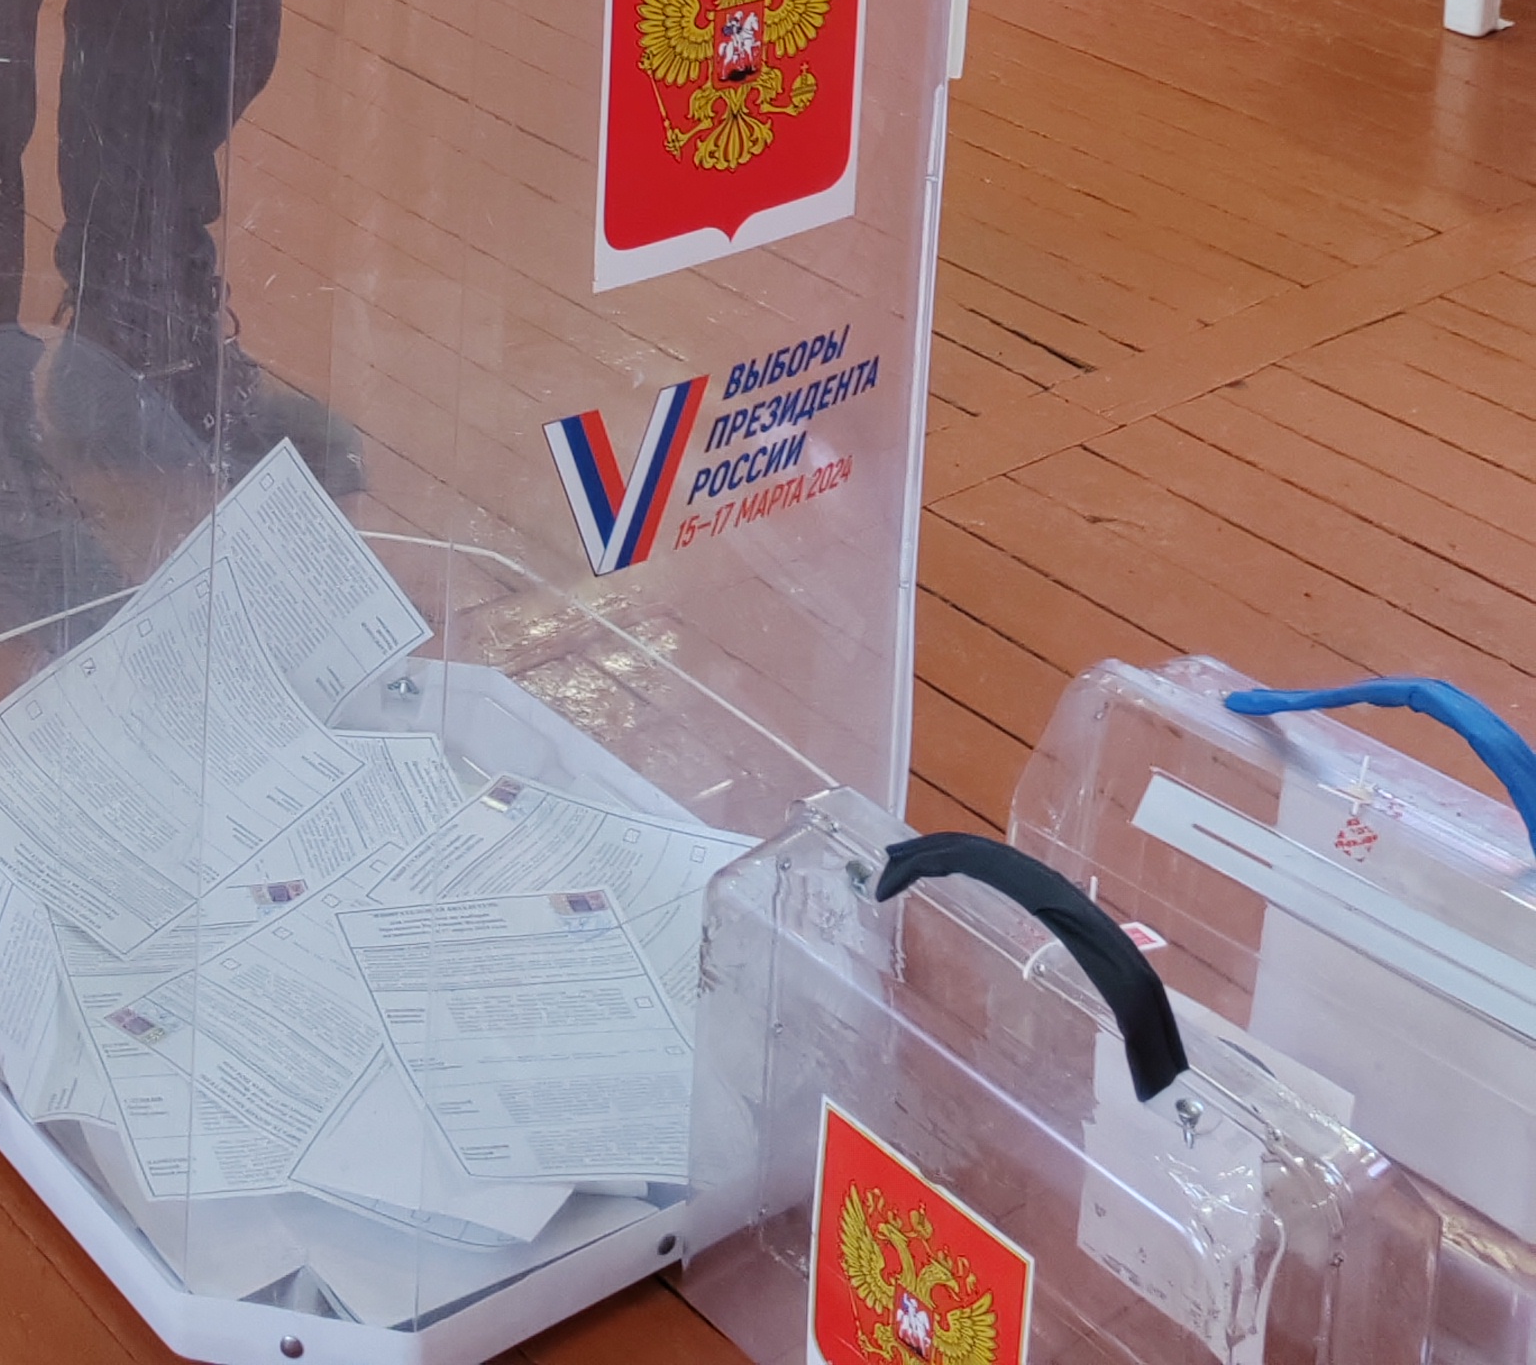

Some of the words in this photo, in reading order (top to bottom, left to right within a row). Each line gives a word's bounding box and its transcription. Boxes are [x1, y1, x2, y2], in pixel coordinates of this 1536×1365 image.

[723, 324, 851, 400] ВЫБОРЫ
[704, 355, 880, 453] ПРЕЗИДЕНТА
[687, 430, 808, 505] РОССИИ
[733, 475, 805, 528] МАРТА
[806, 455, 854, 500] 2024
